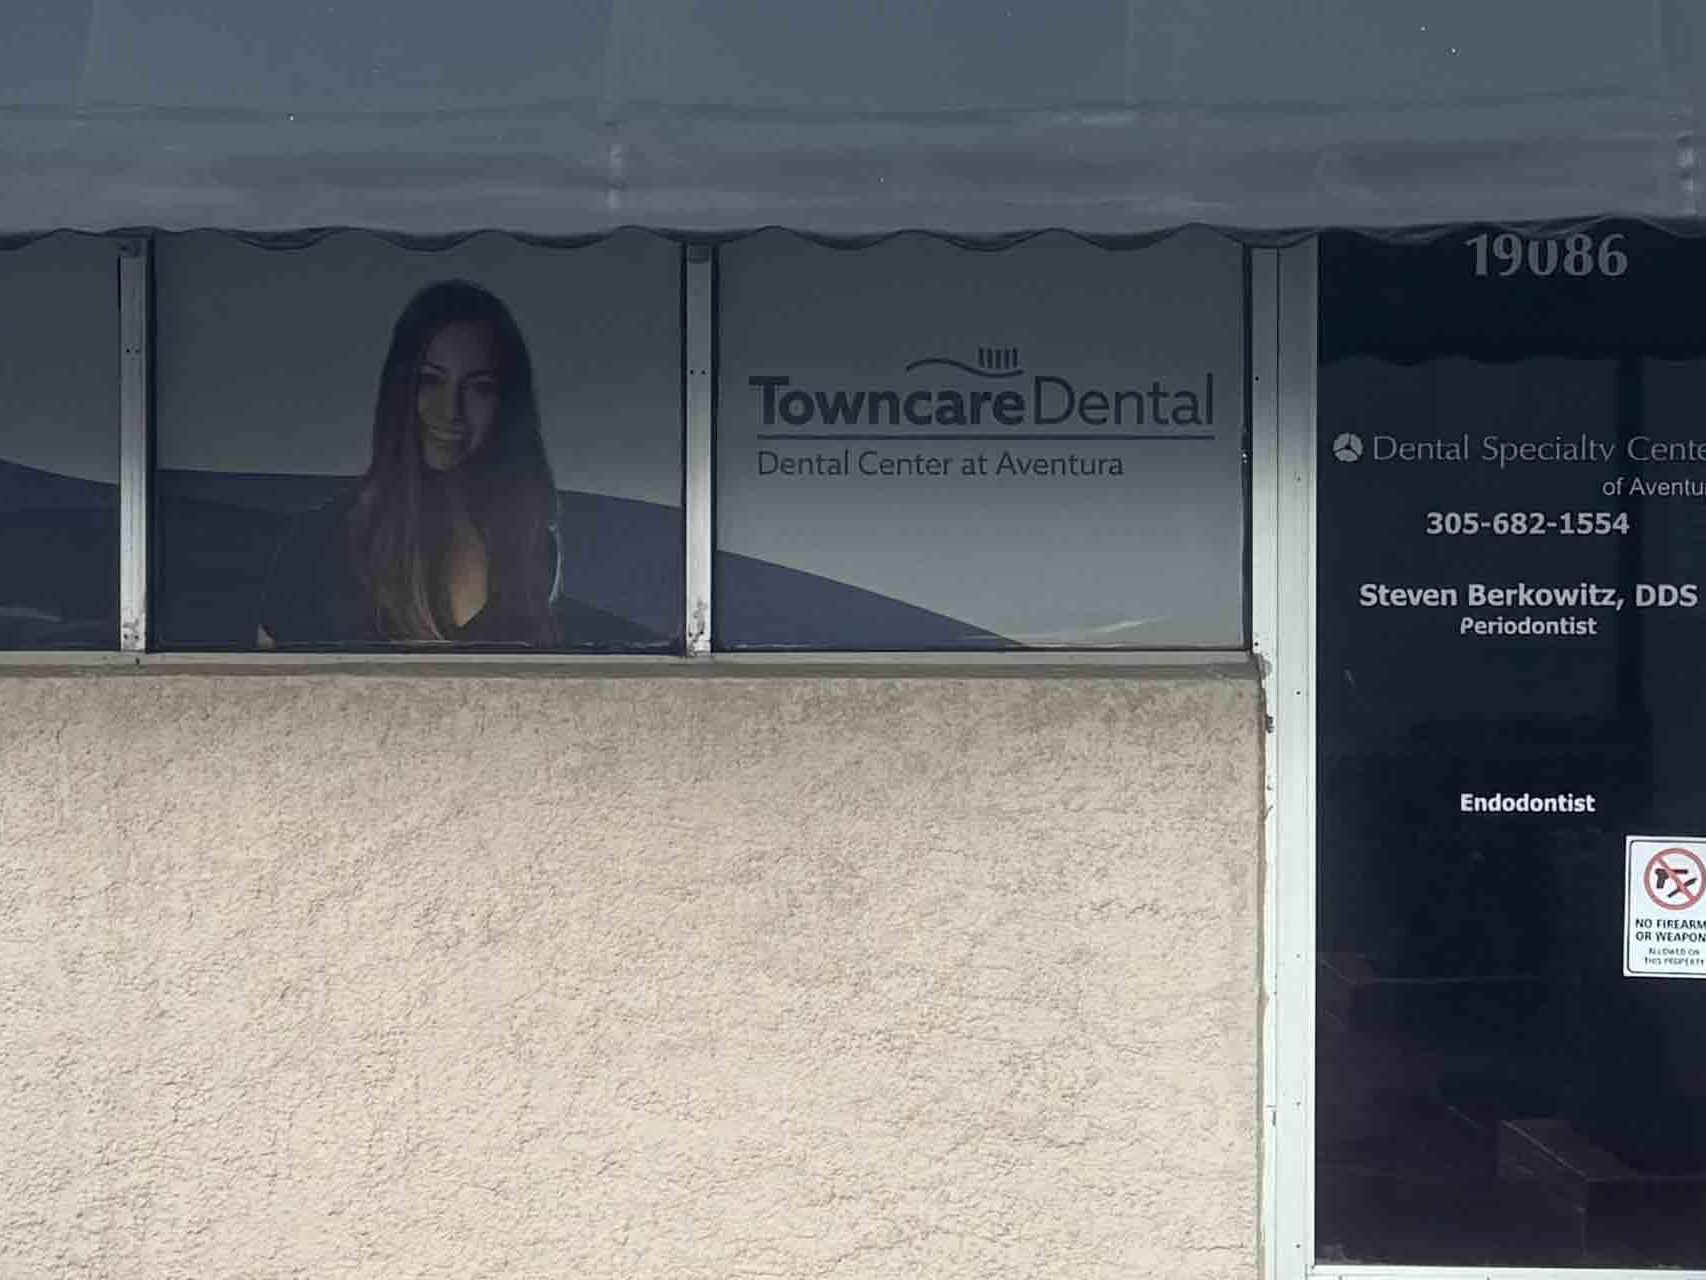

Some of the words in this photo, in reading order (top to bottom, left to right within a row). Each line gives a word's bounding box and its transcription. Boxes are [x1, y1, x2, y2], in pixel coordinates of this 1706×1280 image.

[1464, 232, 1629, 278] 19086
[1373, 434, 1469, 461] Dental
[757, 448, 849, 476] Dental
[858, 448, 952, 476] Center
[961, 452, 989, 476] at
[996, 449, 1124, 476] Aventura
[1602, 477, 1623, 496] of
[1427, 512, 1630, 535] 305-682-1554
[1359, 584, 1457, 607] Steven
[1468, 582, 1625, 611] Berkowitz,
[1635, 584, 1698, 608] DDS
[1460, 616, 1597, 635] Periodontist
[1460, 793, 1596, 813] Endodontist
[1635, 918, 1653, 928] NO
[1635, 931, 1652, 941] OR
